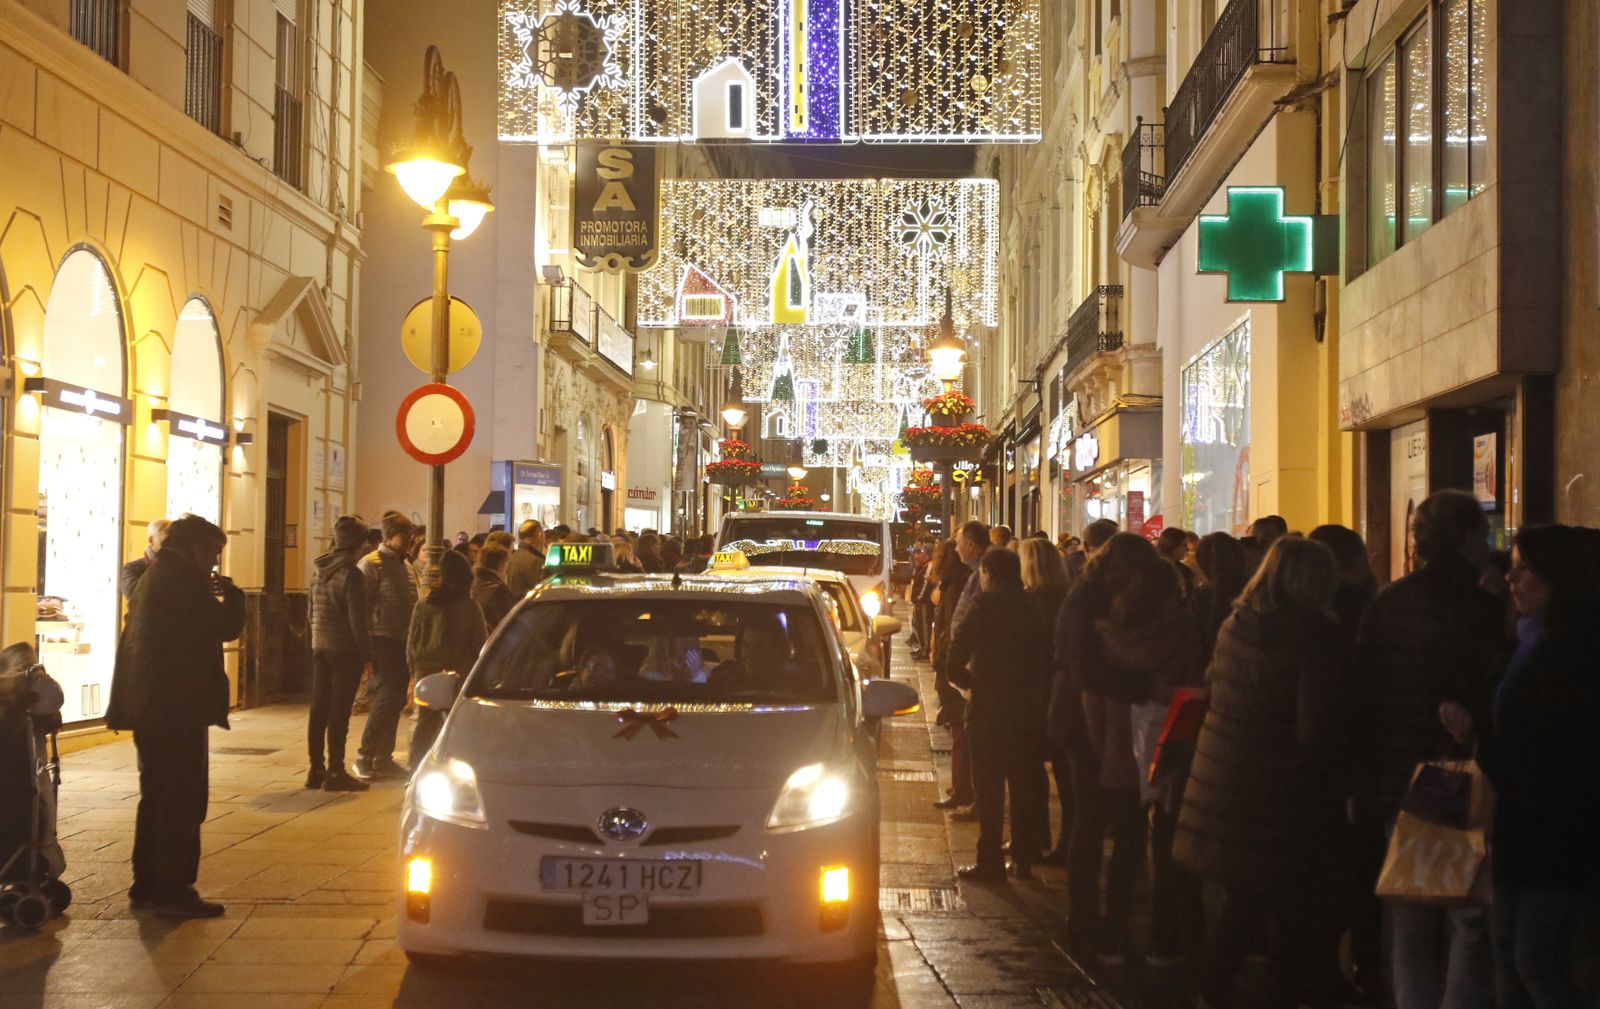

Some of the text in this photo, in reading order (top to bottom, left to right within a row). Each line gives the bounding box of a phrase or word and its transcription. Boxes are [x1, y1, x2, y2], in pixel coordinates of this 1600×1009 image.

[580, 221, 648, 233] PROMOTORA
[580, 234, 648, 247] INMOBILIARIA
[562, 545, 593, 562] TAXI
[714, 553, 734, 562] TAXI
[565, 863, 692, 890] 1241 HCZ
[593, 895, 639, 921] SP
